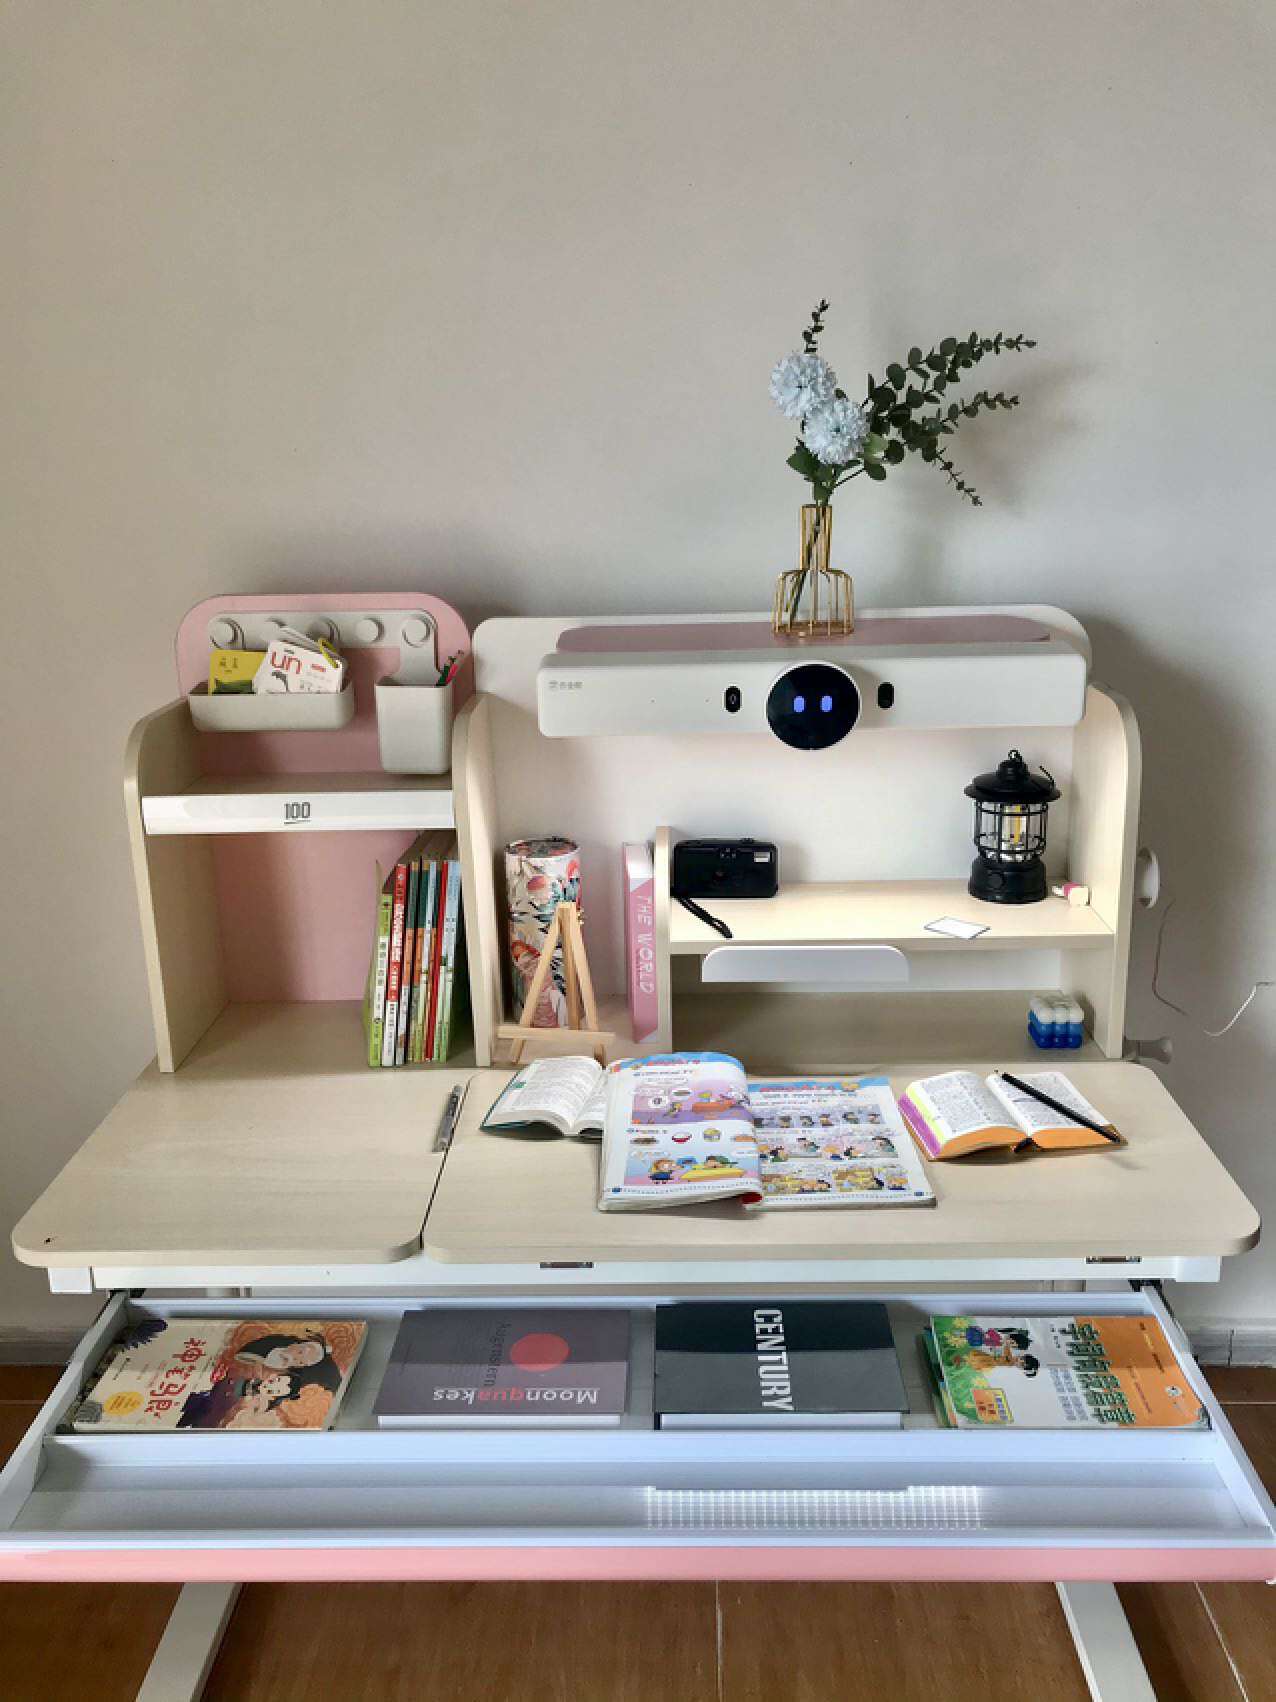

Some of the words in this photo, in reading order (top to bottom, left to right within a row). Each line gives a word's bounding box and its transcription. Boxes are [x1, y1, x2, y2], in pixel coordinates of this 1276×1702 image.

[284, 801, 311, 819] 100
[637, 895, 653, 926] THE
[637, 931, 655, 993] WORLD
[144, 1337, 207, 1418] 神笔马良
[753, 1309, 794, 1411] CENTURY
[433, 1388, 598, 1405] Moonquakes
